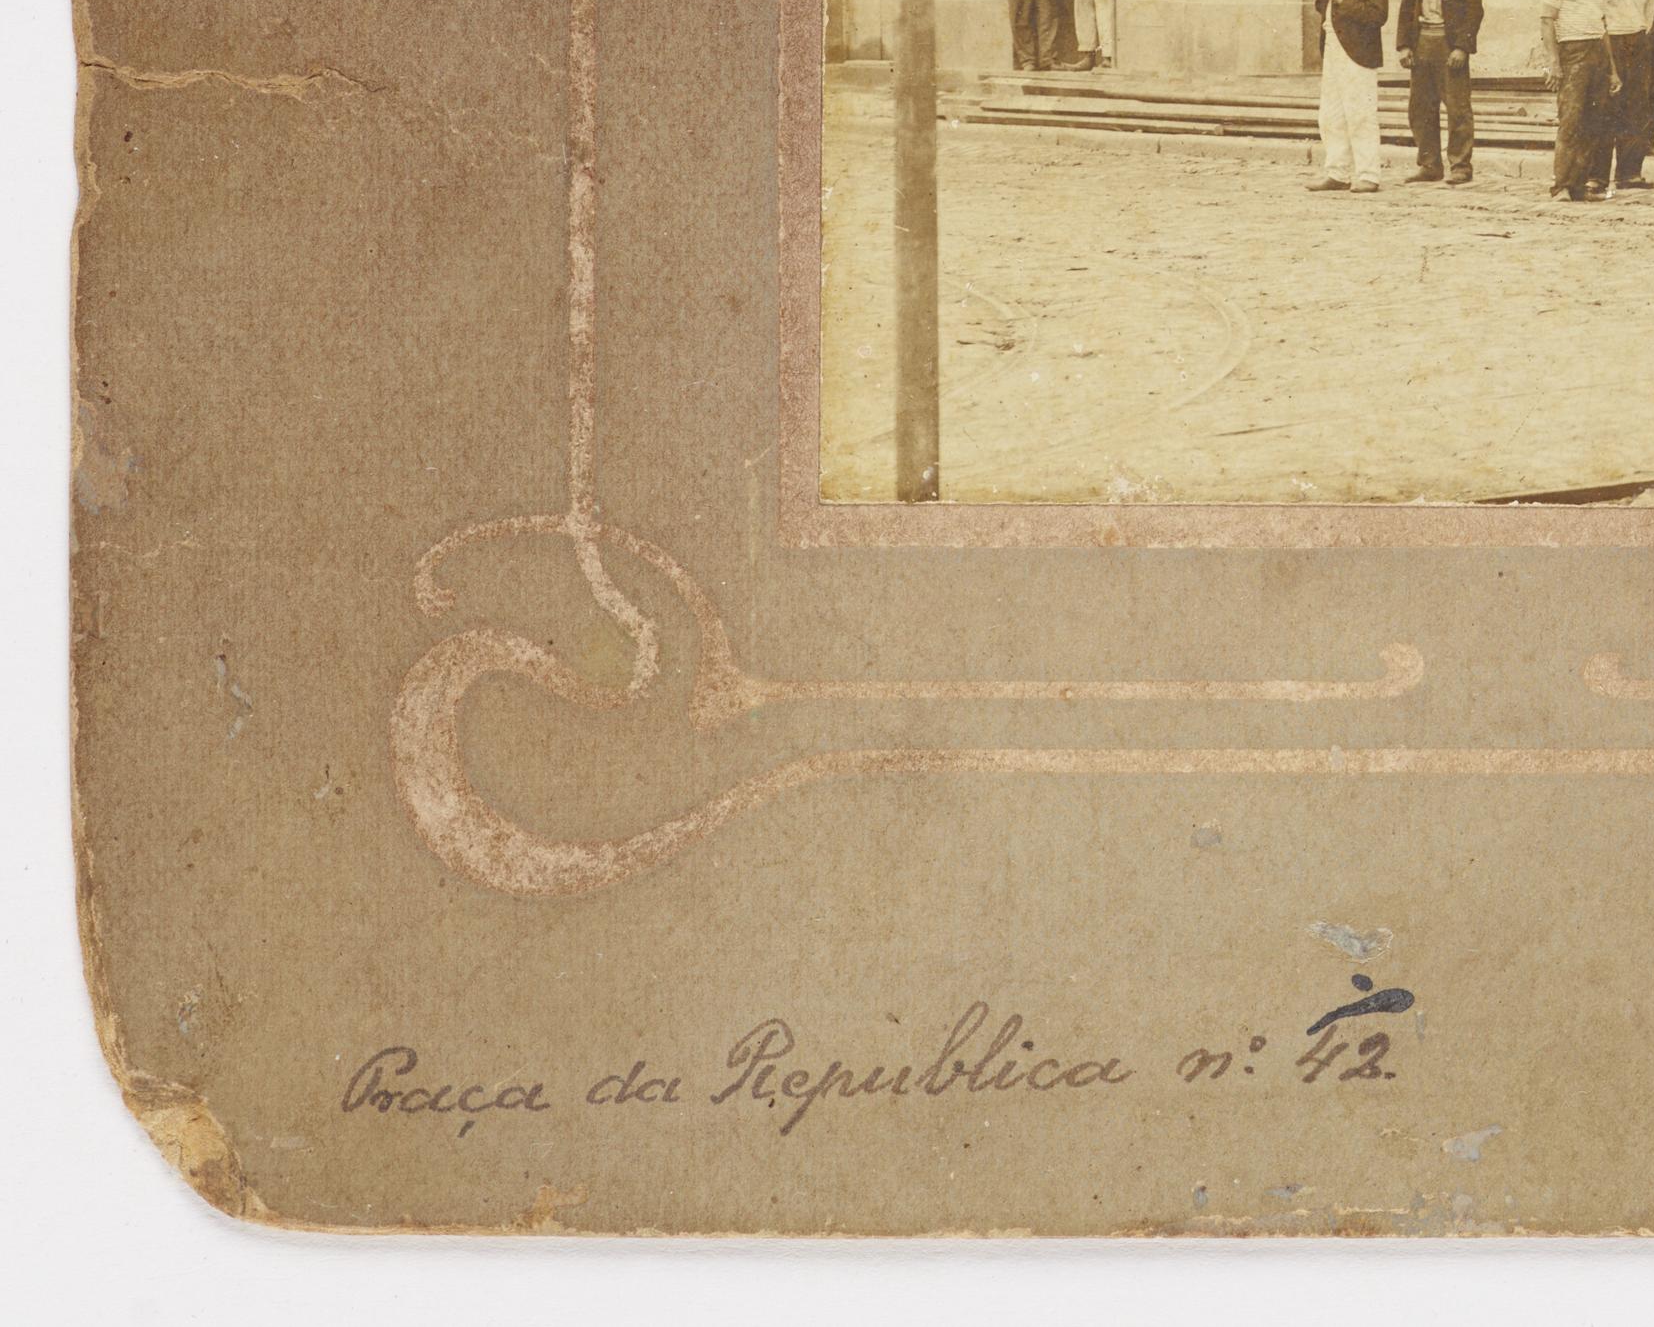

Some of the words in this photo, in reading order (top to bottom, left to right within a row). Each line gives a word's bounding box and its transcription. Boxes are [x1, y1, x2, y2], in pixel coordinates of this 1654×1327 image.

[341, 1045, 551, 1139] Praça
[586, 1058, 682, 1106] da
[709, 1002, 1133, 1134] Republica
